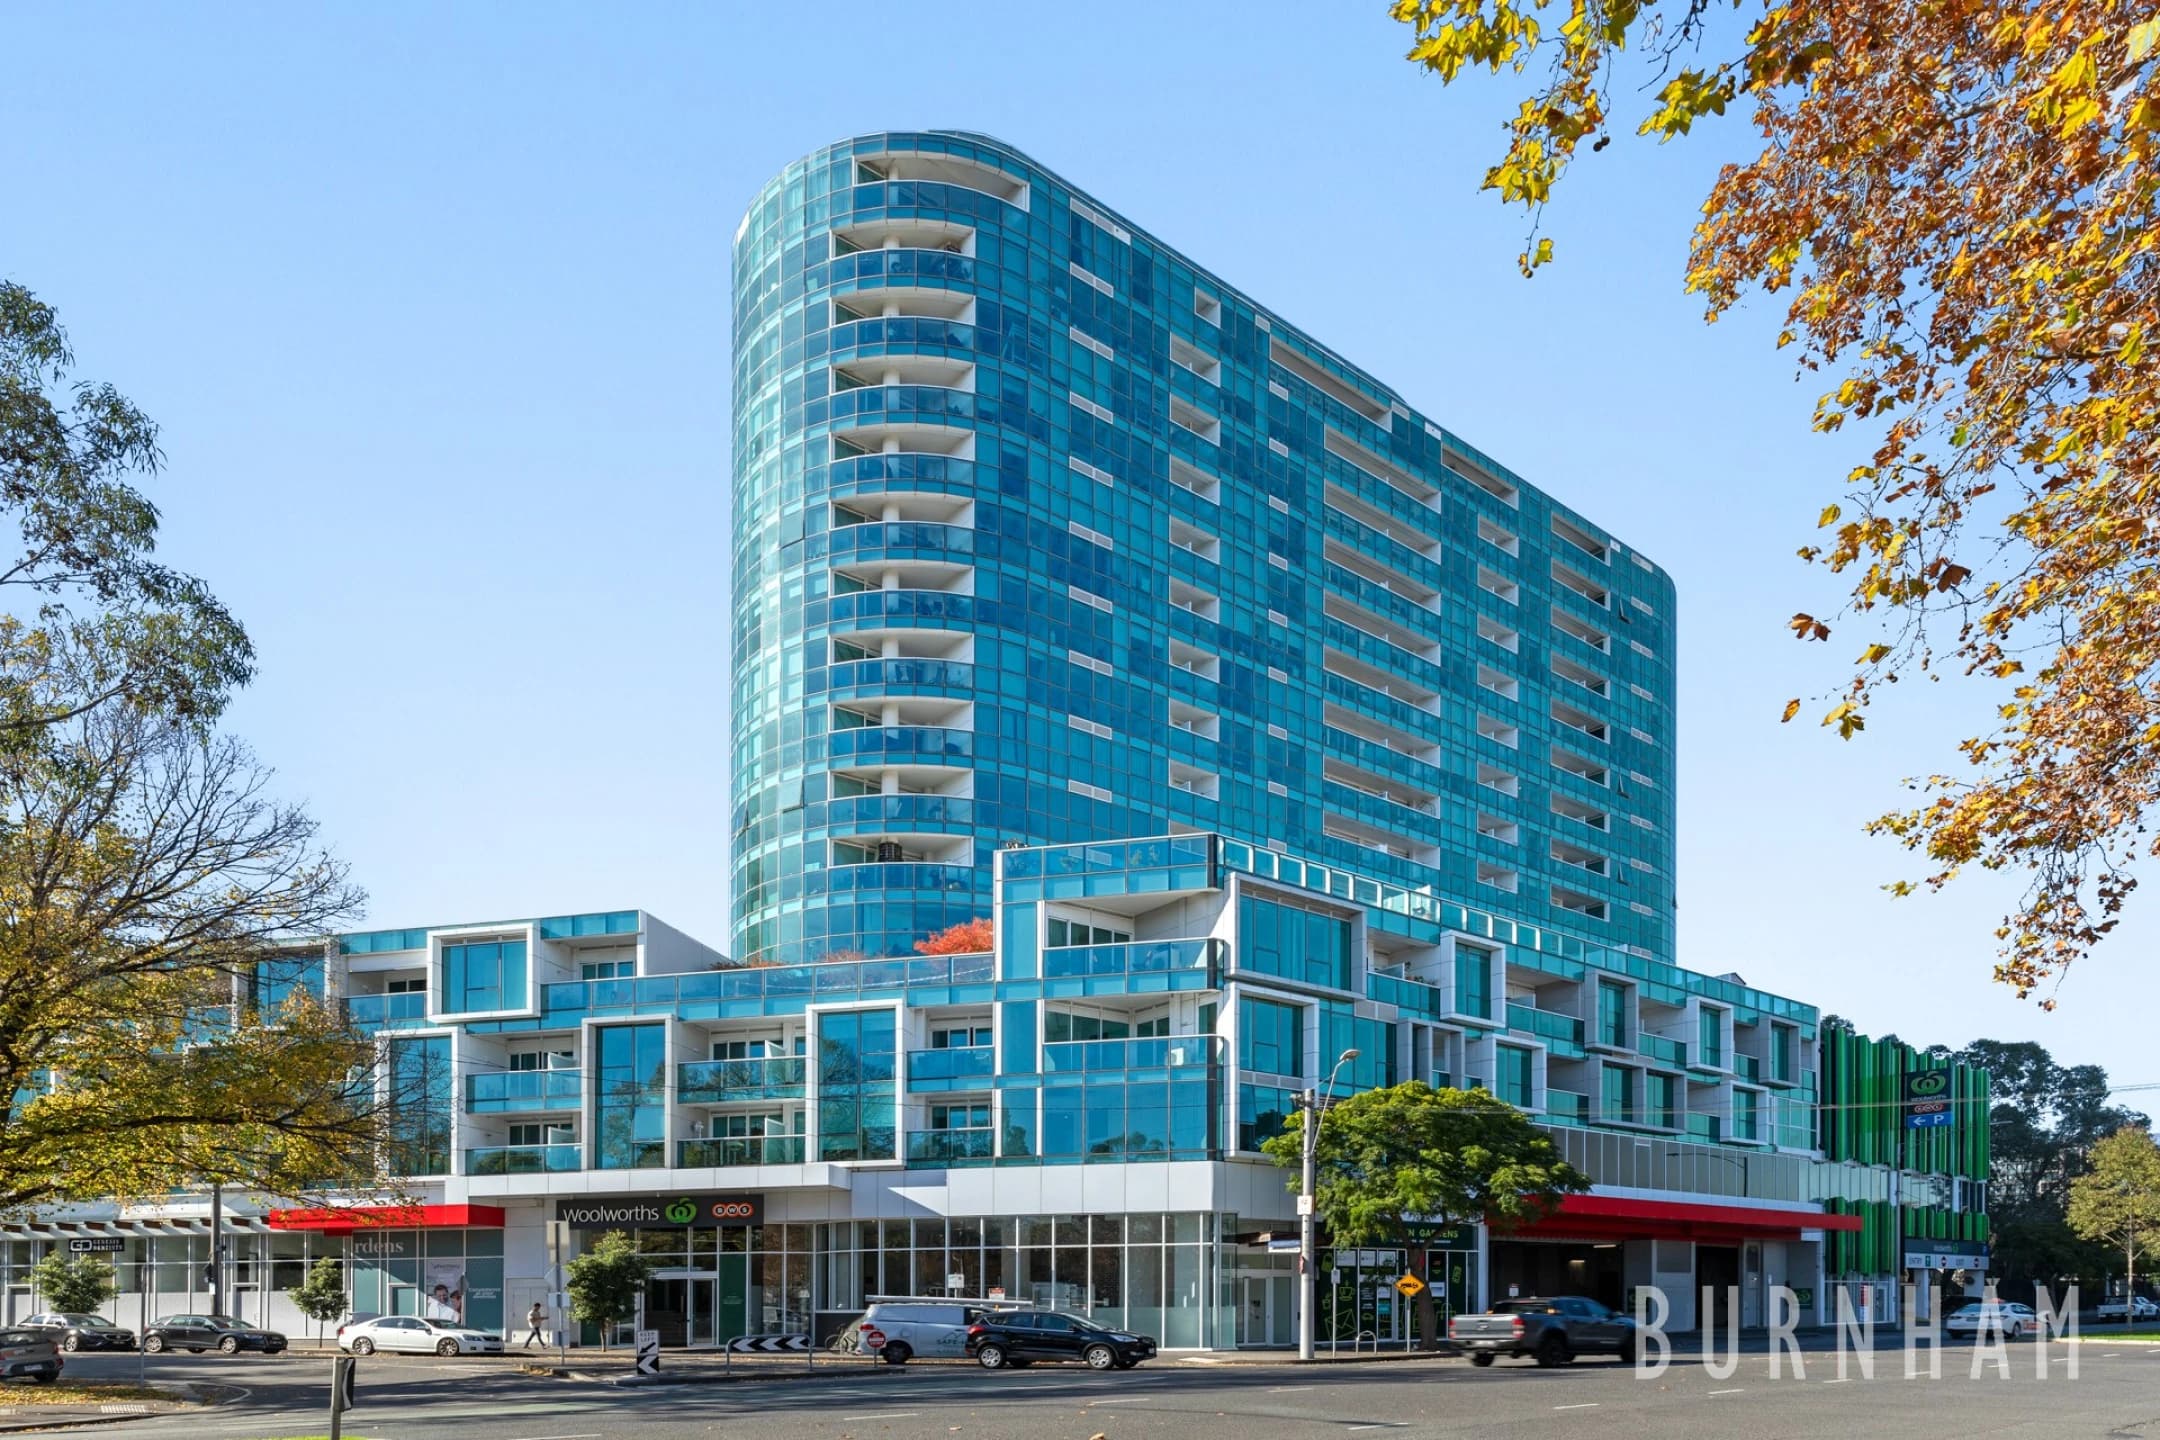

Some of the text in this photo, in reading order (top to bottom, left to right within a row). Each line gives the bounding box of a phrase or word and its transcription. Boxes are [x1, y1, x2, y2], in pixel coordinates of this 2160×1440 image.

[1934, 1114, 1945, 1125] P
[563, 1204, 660, 1223] Woolworths
[714, 1204, 750, 1217] BWS
